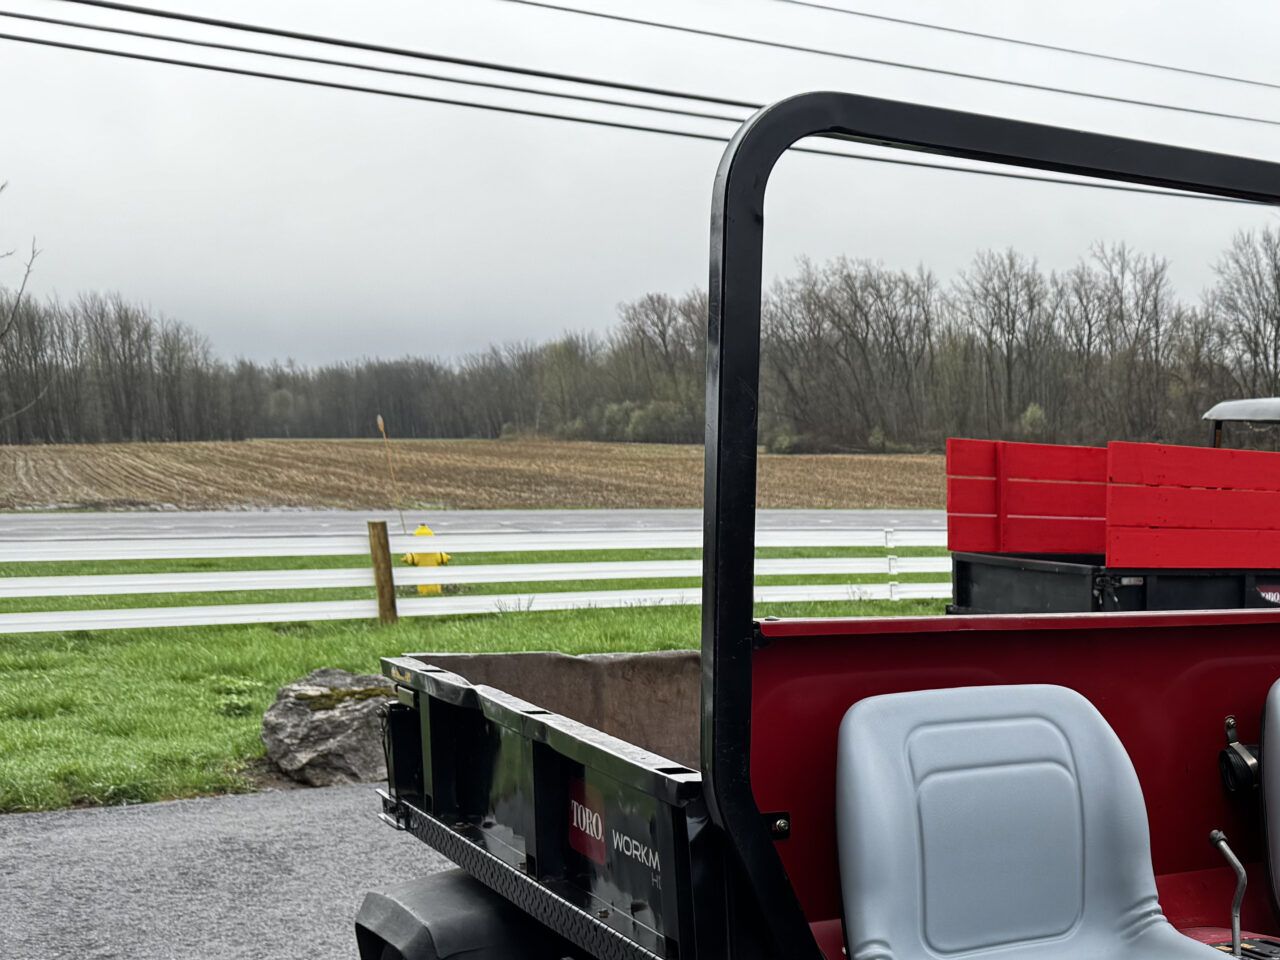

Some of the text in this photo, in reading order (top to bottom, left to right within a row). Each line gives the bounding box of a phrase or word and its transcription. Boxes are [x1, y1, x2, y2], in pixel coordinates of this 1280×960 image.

[1261, 592, 1280, 602] ORO
[571, 800, 603, 841] TORO
[612, 829, 661, 872] WORKM
